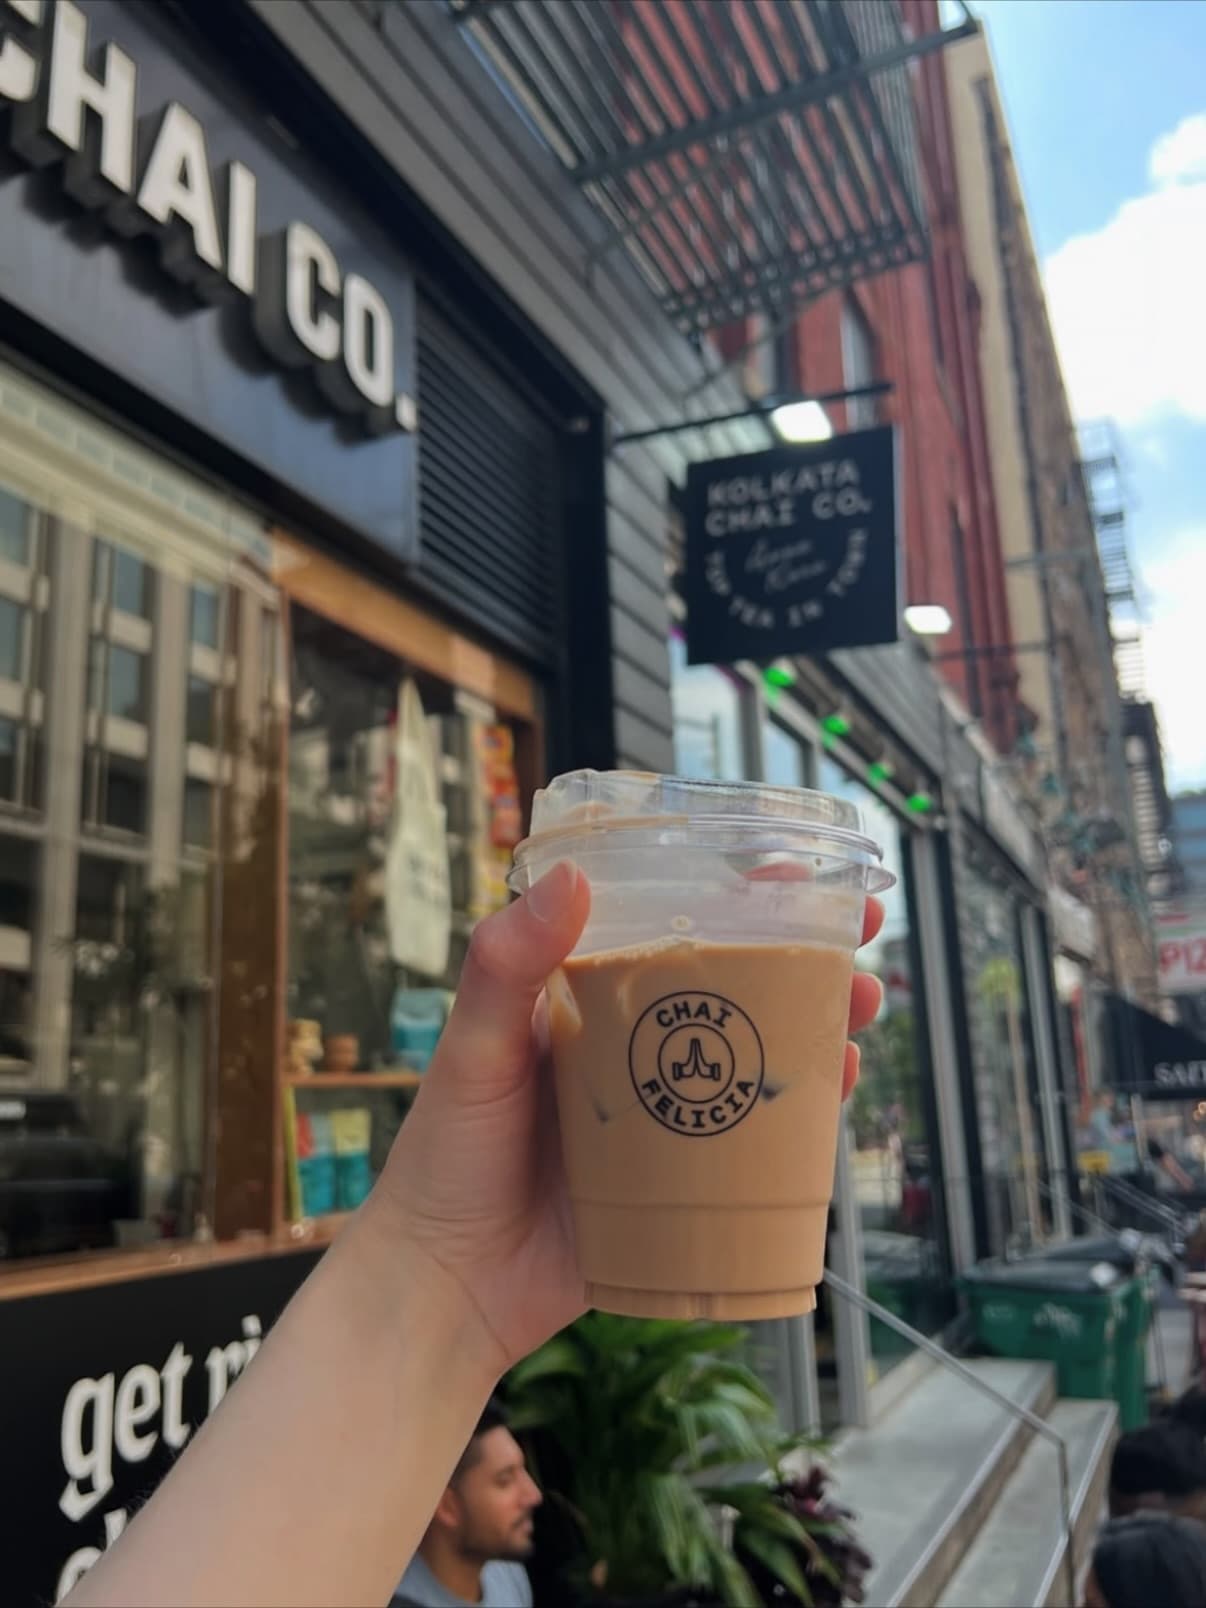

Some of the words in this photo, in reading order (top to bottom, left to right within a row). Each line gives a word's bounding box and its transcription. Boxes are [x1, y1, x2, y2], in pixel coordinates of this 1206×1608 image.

[287, 222, 417, 431] CO.
[707, 458, 860, 505] KOLKATA
[705, 500, 795, 537] CHAI
[811, 486, 872, 519] CO.
[656, 1000, 732, 1028] CHAI
[641, 1078, 755, 1128] FELICIA
[58, 1340, 193, 1522] get
